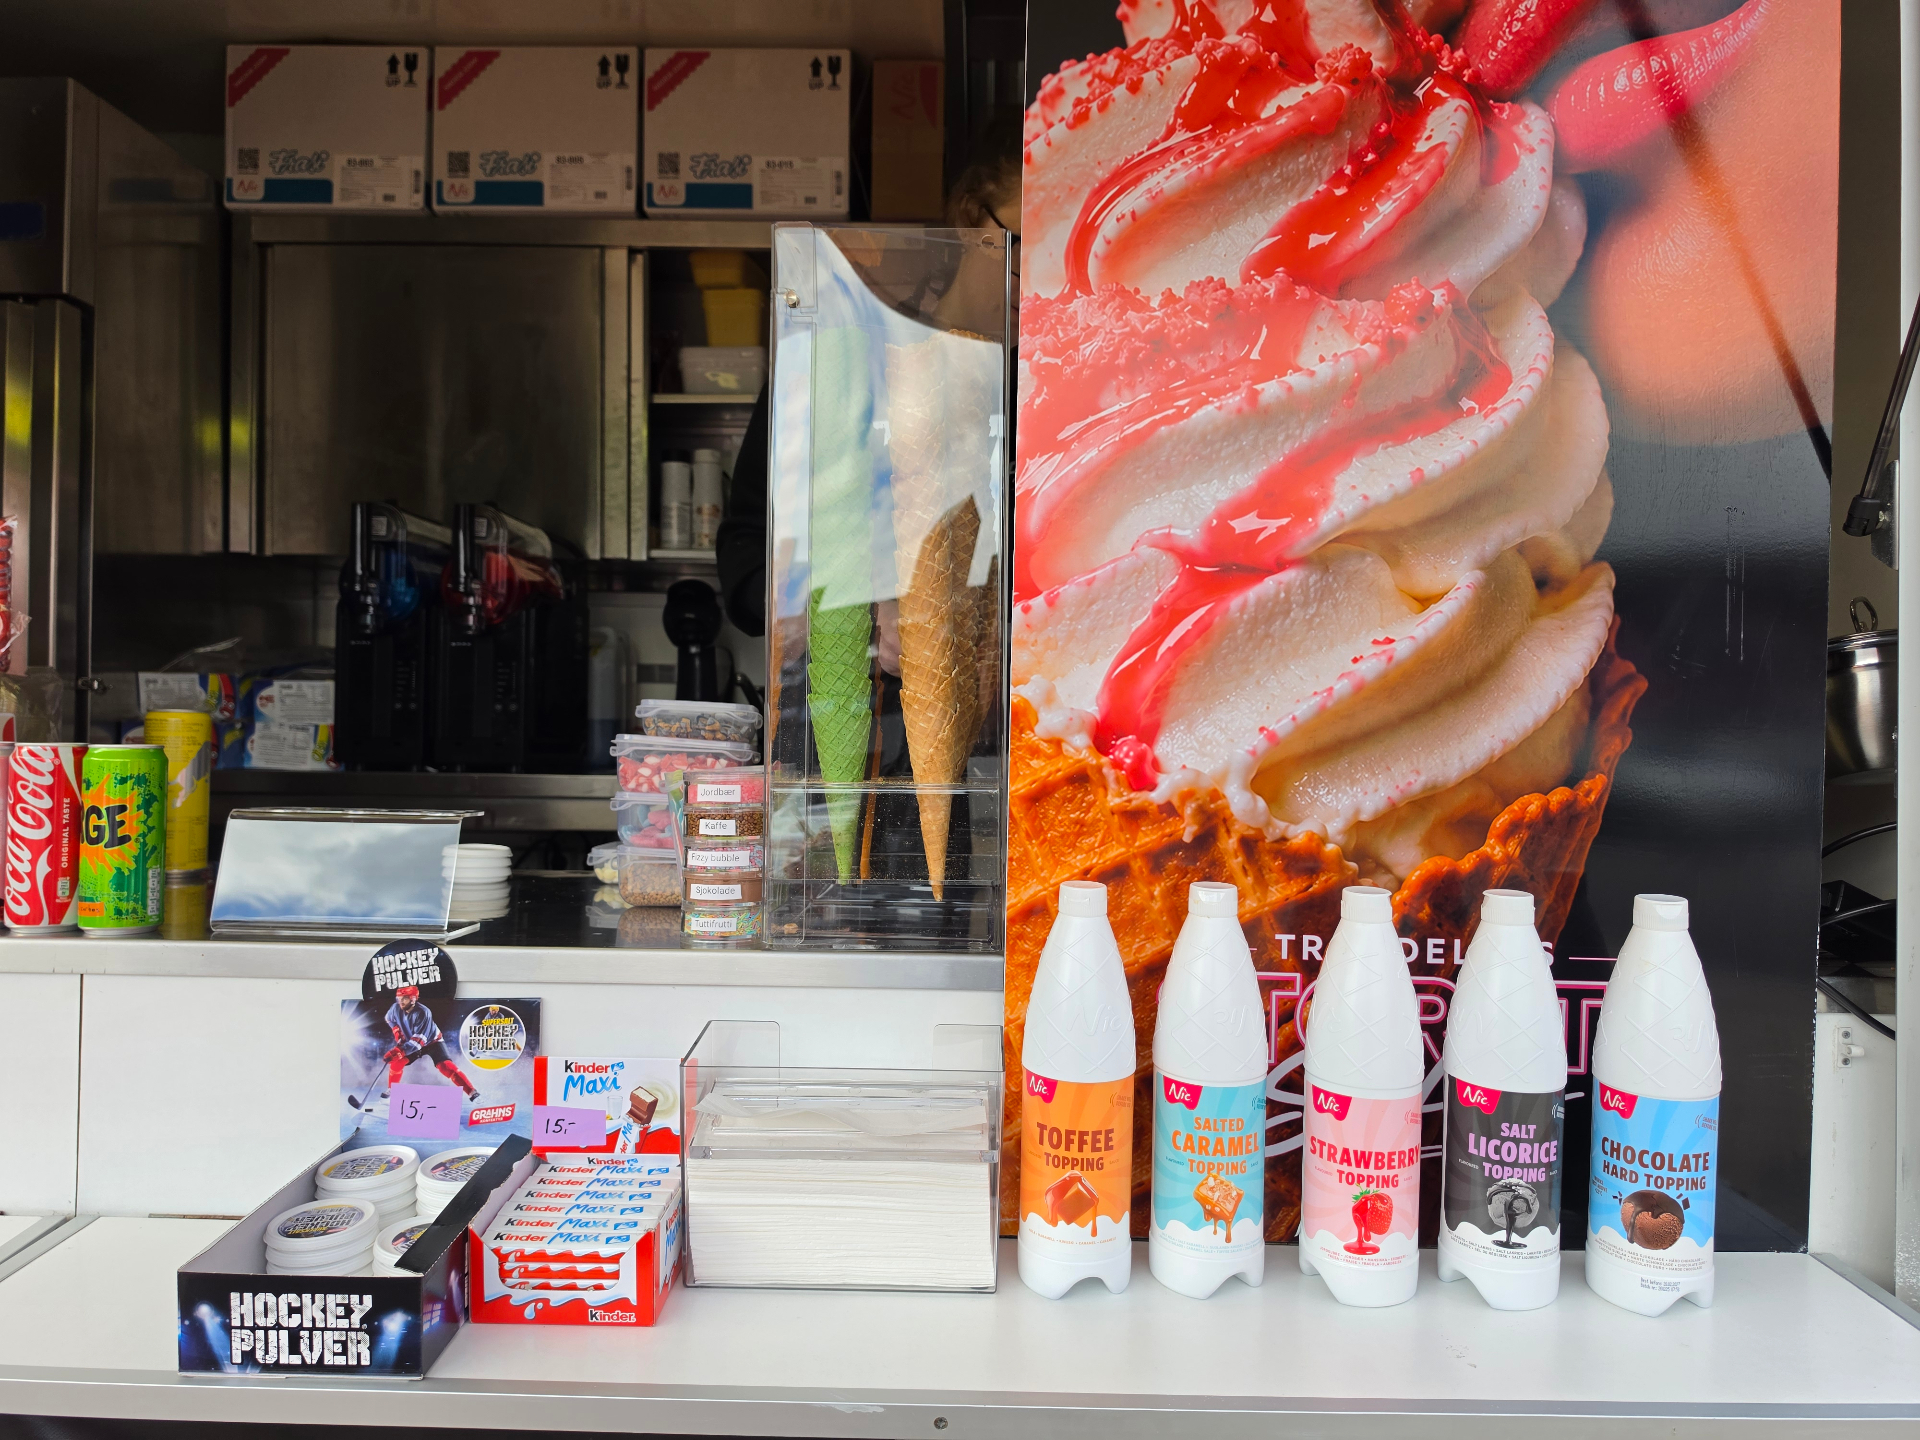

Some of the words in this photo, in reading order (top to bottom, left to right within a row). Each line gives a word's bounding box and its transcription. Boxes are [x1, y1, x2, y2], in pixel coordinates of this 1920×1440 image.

[700, 787, 736, 797] Jordbær
[61, 797, 71, 824] TASTE
[4, 746, 57, 922] oca-Cola
[705, 821, 728, 831] Kaffe
[61, 826, 70, 868] ORIGINAL
[691, 853, 709, 864] Fizzy
[710, 853, 740, 863] bubble
[695, 885, 736, 896] Sjokolade
[694, 919, 733, 929] Tuttifrutti
[372, 947, 439, 974] HOCKEY
[374, 965, 441, 992] PULVER
[469, 1025, 518, 1037] HOCKEY
[469, 1038, 517, 1051] PULVER
[563, 1072, 621, 1101] Maxi
[472, 1107, 512, 1120] GRAHNS
[1194, 1116, 1245, 1132] SALTED
[1500, 1122, 1536, 1139] SALT
[1036, 1121, 1115, 1153] TOFFEE
[1171, 1130, 1259, 1157] CARAMEL
[1309, 1135, 1420, 1170] STRAWBERRY
[1468, 1132, 1558, 1164] LICORICE
[1601, 1136, 1710, 1173] CHOCOLATE
[1044, 1151, 1104, 1171] TOPPING
[1188, 1158, 1247, 1175] TOPPING
[596, 1165, 643, 1176] Maxi
[1336, 1169, 1399, 1188] TOPPING
[1482, 1161, 1545, 1182] TOPPING
[1603, 1159, 1639, 1184] HARD
[1643, 1173, 1706, 1191] TOPPING
[585, 1178, 635, 1188] Maxi
[574, 1190, 625, 1201] Maxi
[564, 1204, 617, 1215] Maxi
[557, 1218, 610, 1230] Maxi
[547, 1232, 602, 1245] Maxi
[230, 1292, 372, 1328] HOCKEY
[231, 1329, 371, 1365] PULVER
